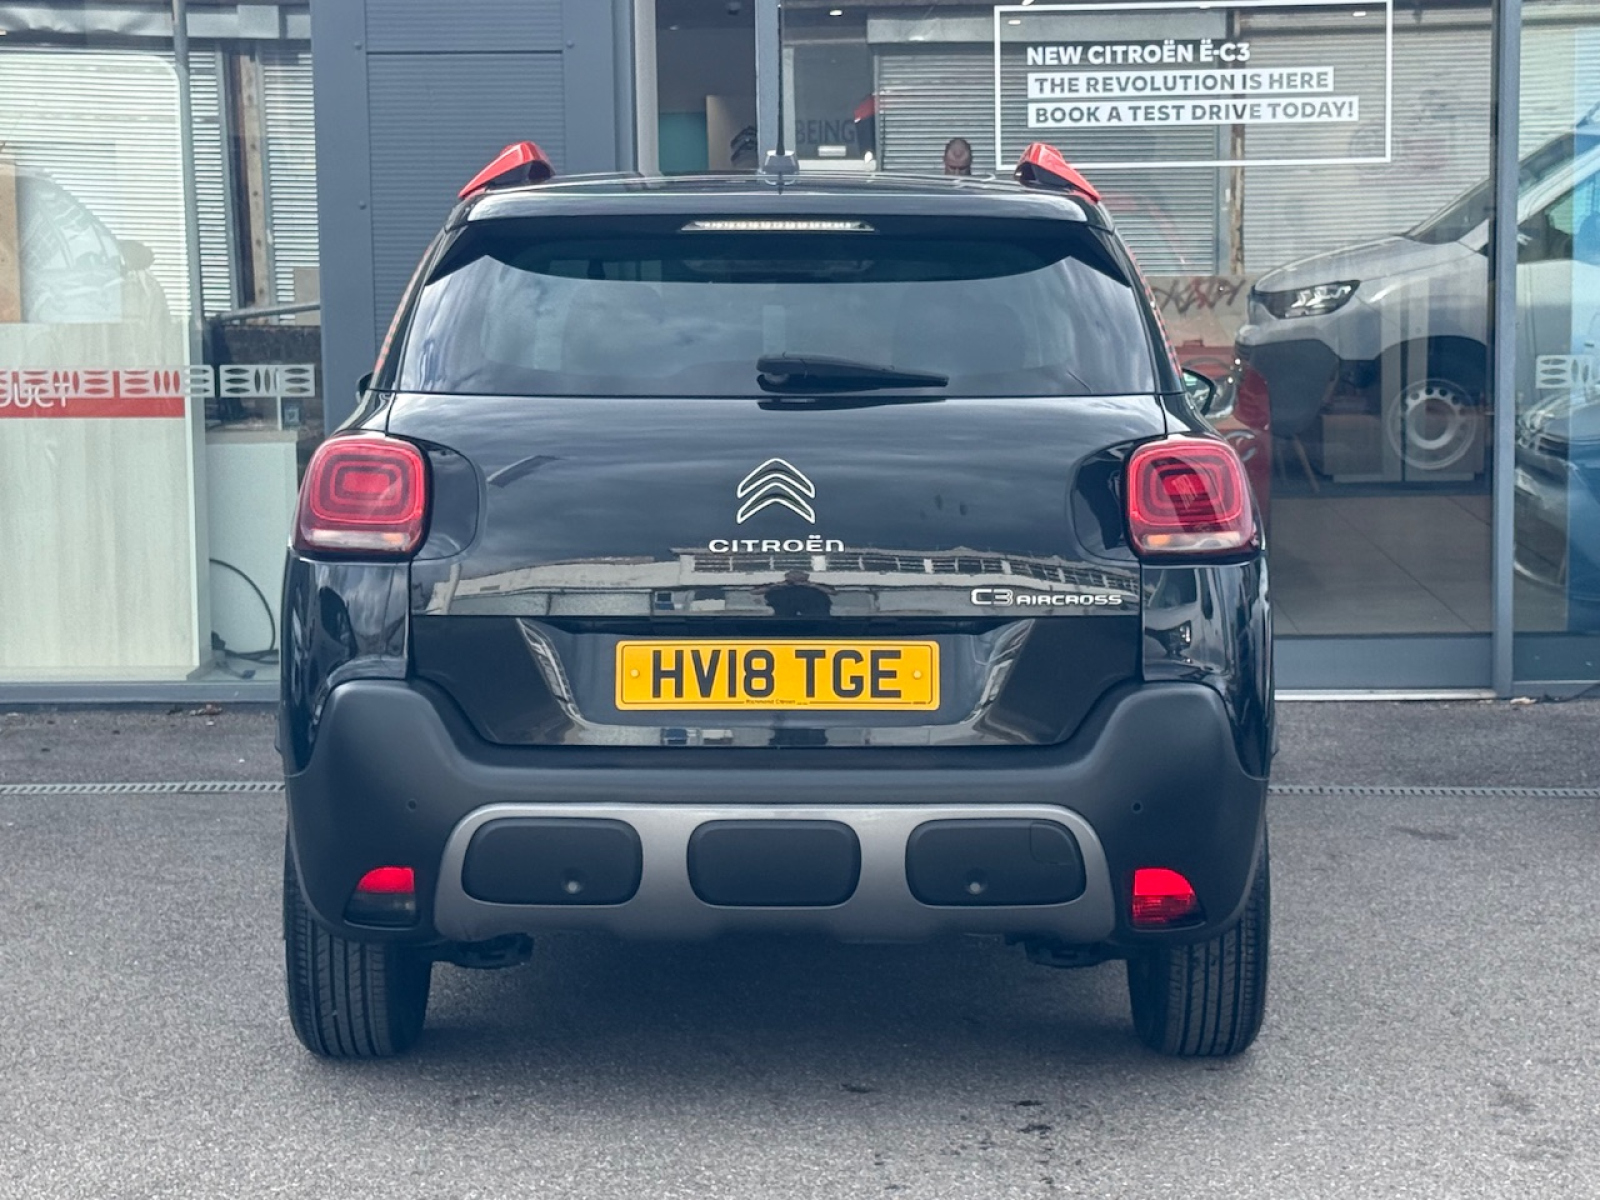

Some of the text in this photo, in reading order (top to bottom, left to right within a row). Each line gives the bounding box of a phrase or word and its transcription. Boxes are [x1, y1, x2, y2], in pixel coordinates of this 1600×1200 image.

[1026, 38, 1250, 65] NEW CITROËN Ë-C3
[1034, 71, 1329, 94] THE REVOLUTION IS HERE
[1035, 100, 1354, 124] BOOK A TEST DRIVE TODAY!
[708, 534, 846, 553] CITROËN
[970, 588, 1123, 606] C3 AIRCROSS
[652, 649, 902, 699] HV18 TGE
